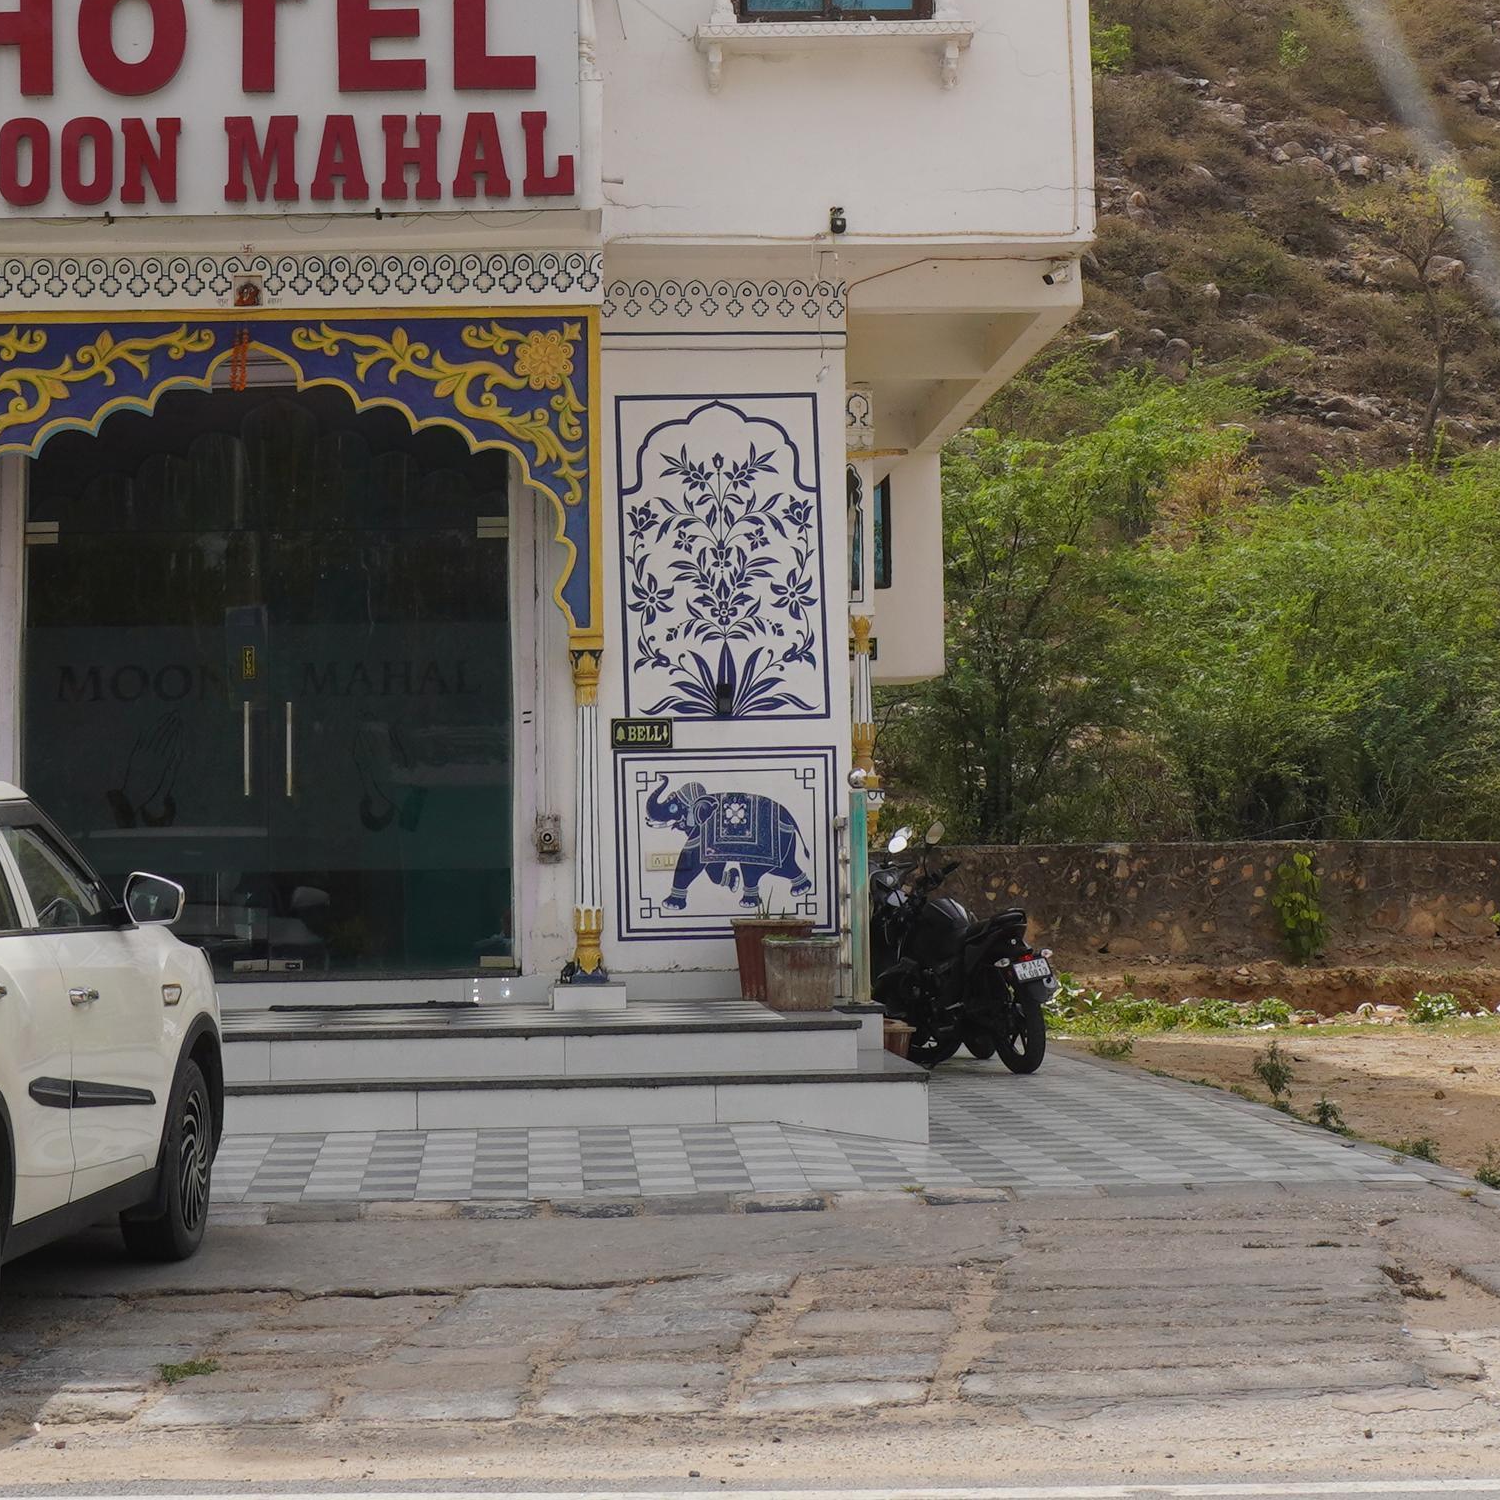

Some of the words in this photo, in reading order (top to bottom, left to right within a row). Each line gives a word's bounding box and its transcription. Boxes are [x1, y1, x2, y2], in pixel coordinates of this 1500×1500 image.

[224, 111, 574, 202] MAHAL
[301, 660, 481, 698] MAHAL
[627, 725, 661, 741] BELL
